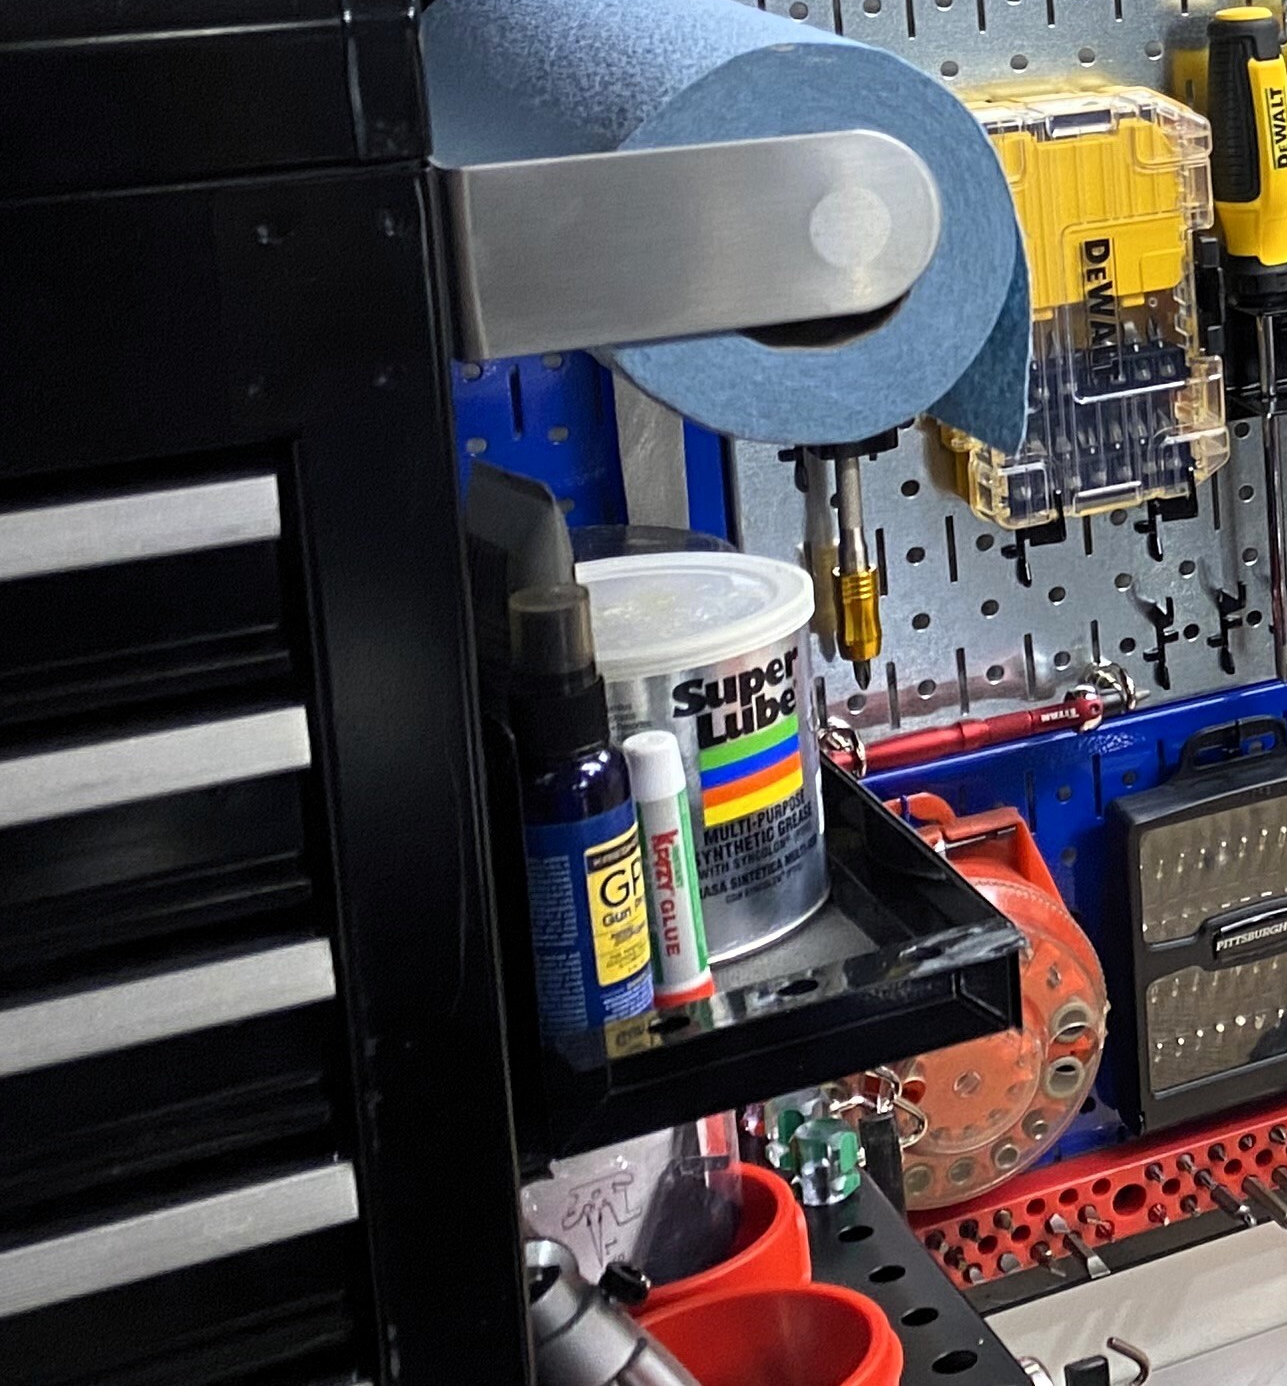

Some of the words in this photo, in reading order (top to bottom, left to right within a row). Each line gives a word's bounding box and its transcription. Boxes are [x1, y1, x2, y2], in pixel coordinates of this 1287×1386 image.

[672, 647, 798, 718] Super
[697, 686, 797, 750] Lube
[703, 788, 806, 846] MULTI-PURPOSE
[778, 804, 813, 836] GREASE
[660, 899, 681, 957] GLUE
